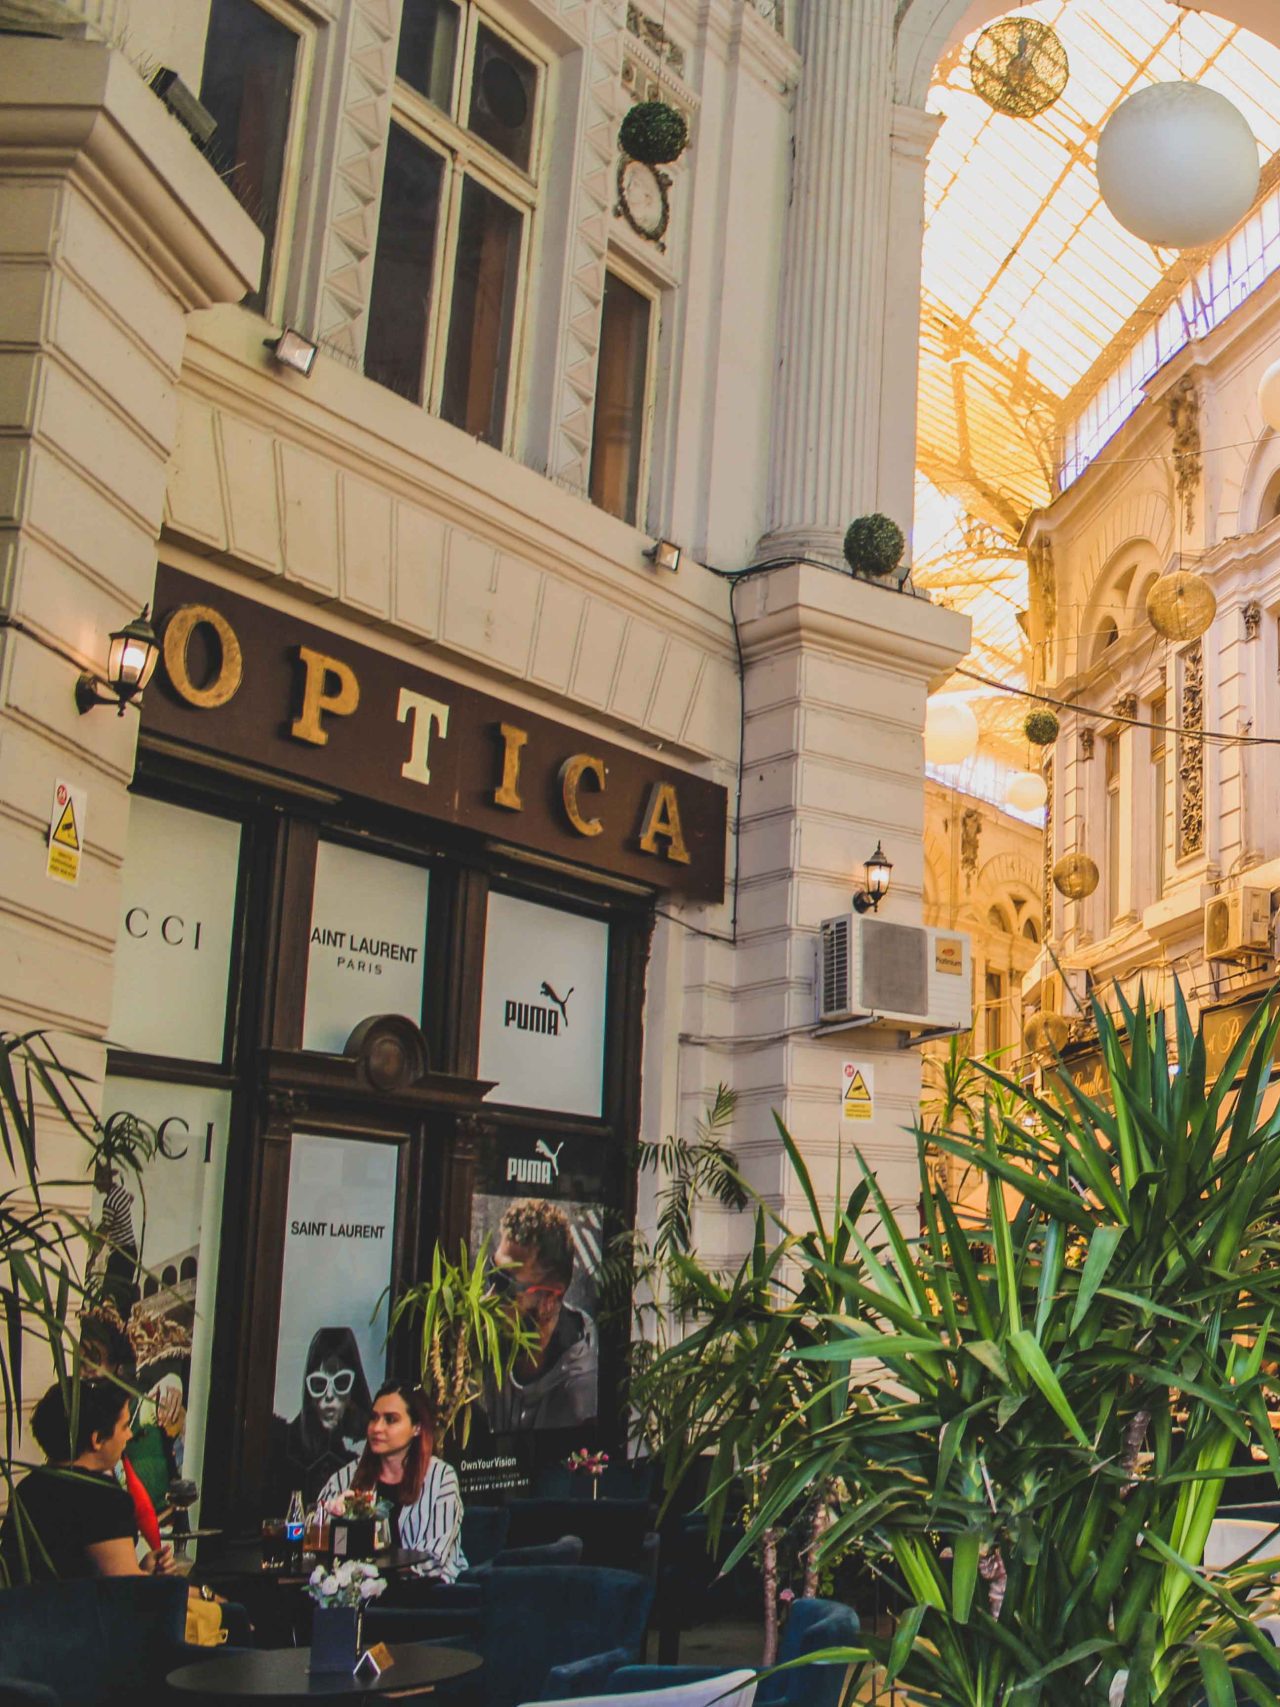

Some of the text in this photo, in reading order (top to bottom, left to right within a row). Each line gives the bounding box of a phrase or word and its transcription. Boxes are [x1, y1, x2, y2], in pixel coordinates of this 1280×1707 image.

[163, 603, 691, 865] OPTICA
[350, 935, 418, 964] LAURENT
[337, 957, 382, 975] PARIS
[505, 1000, 559, 1036] PUMA
[507, 1157, 551, 1184] PUMA
[291, 1221, 385, 1239] SAINT LAURENT
[461, 1456, 517, 1471] OwnYourVision
